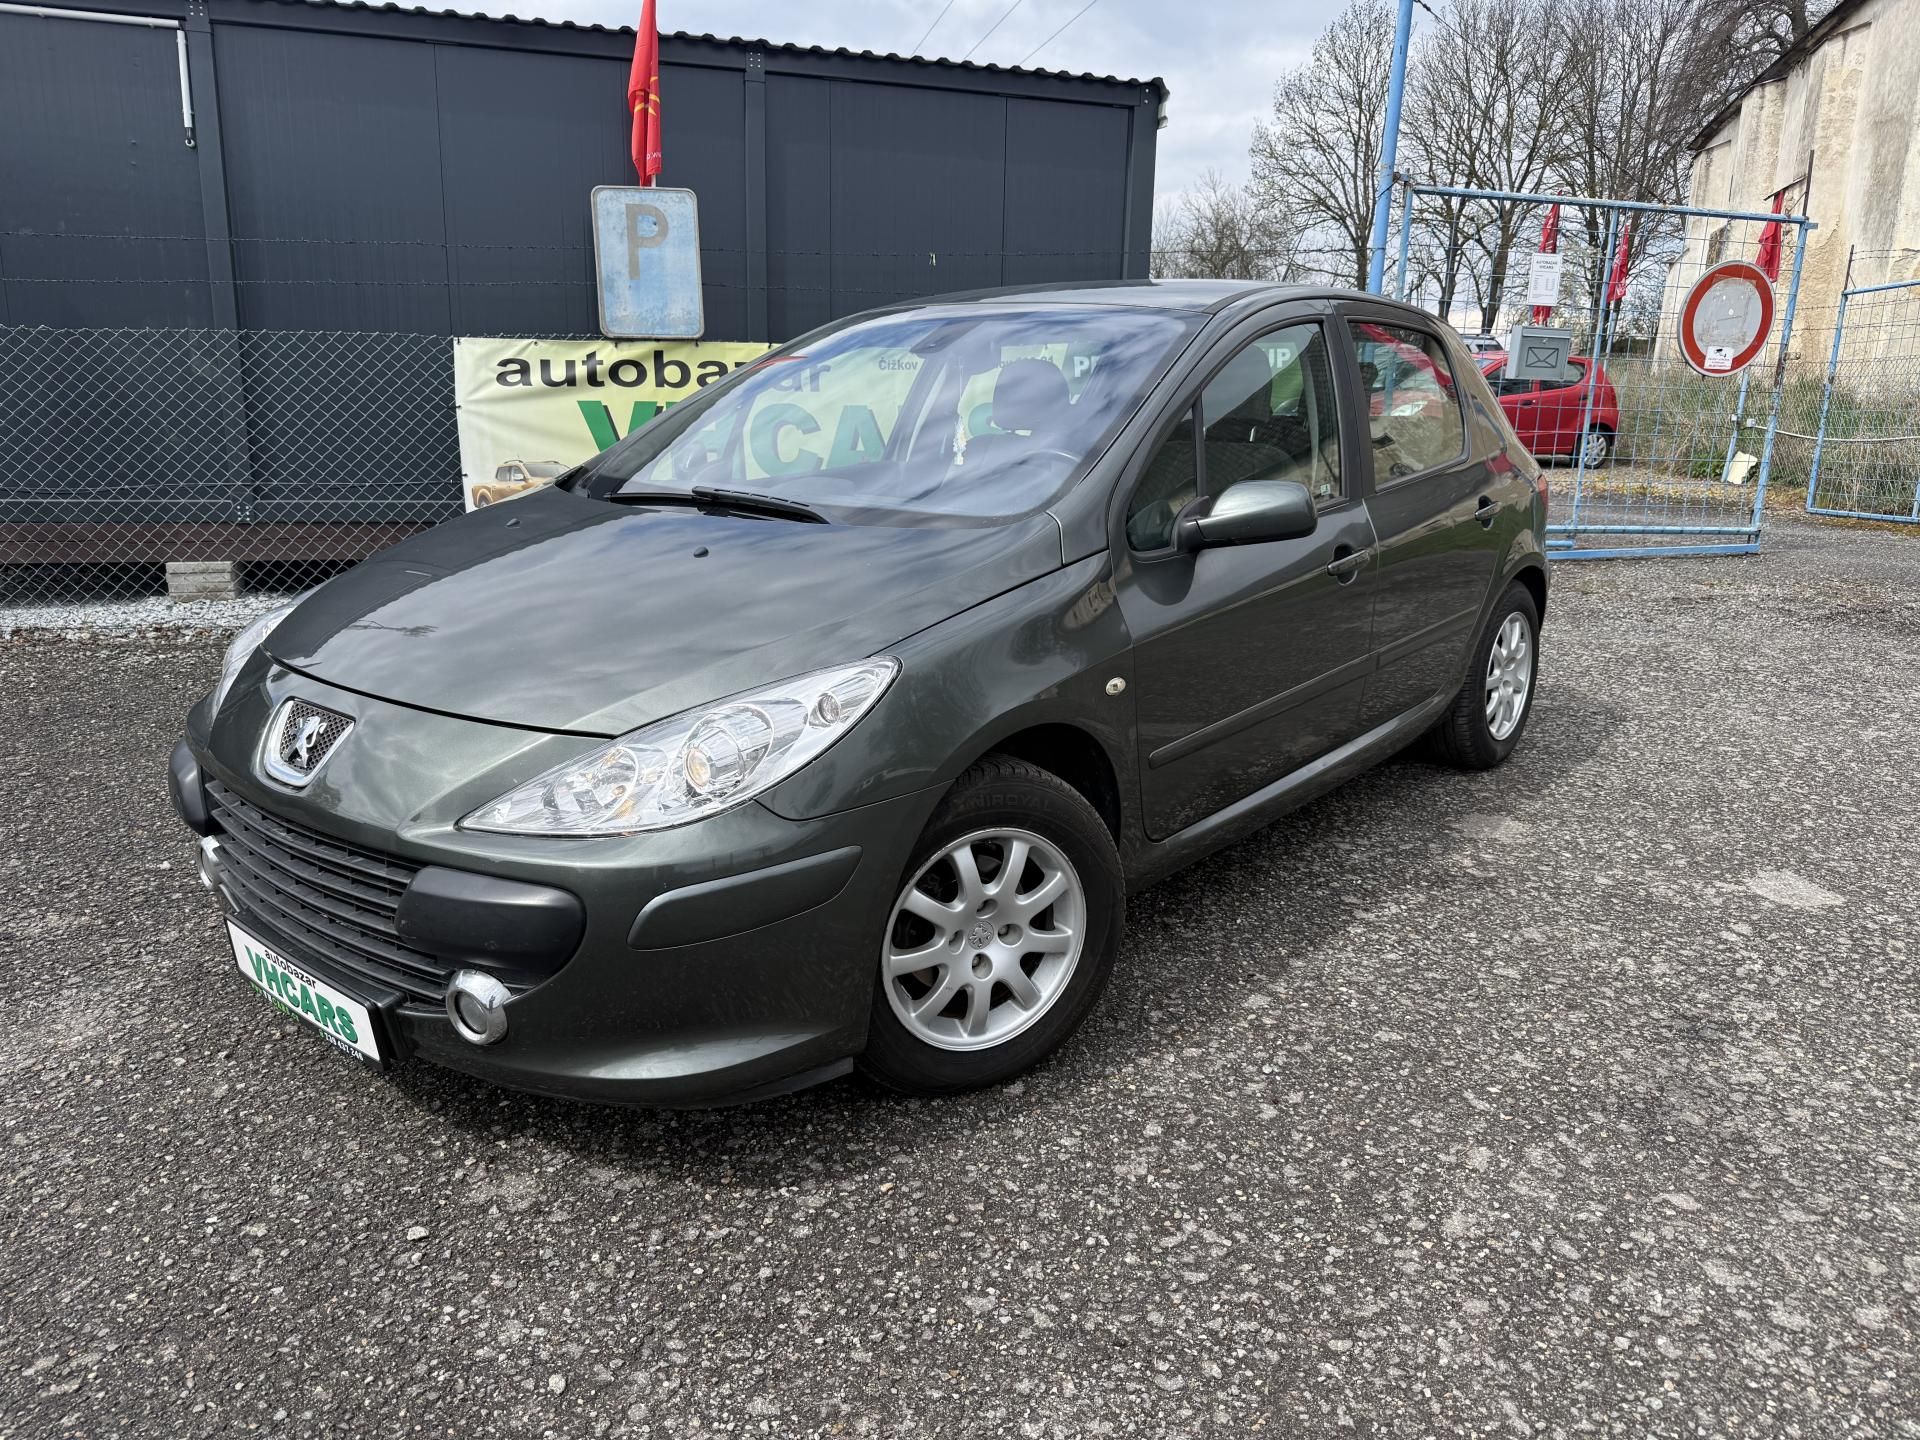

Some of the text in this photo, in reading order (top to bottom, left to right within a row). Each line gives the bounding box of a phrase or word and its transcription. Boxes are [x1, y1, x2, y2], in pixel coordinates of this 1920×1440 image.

[625, 203, 669, 281] P
[495, 350, 831, 392] autobaar
[244, 944, 358, 1044] VHCARS
[264, 950, 317, 989] autobazar
